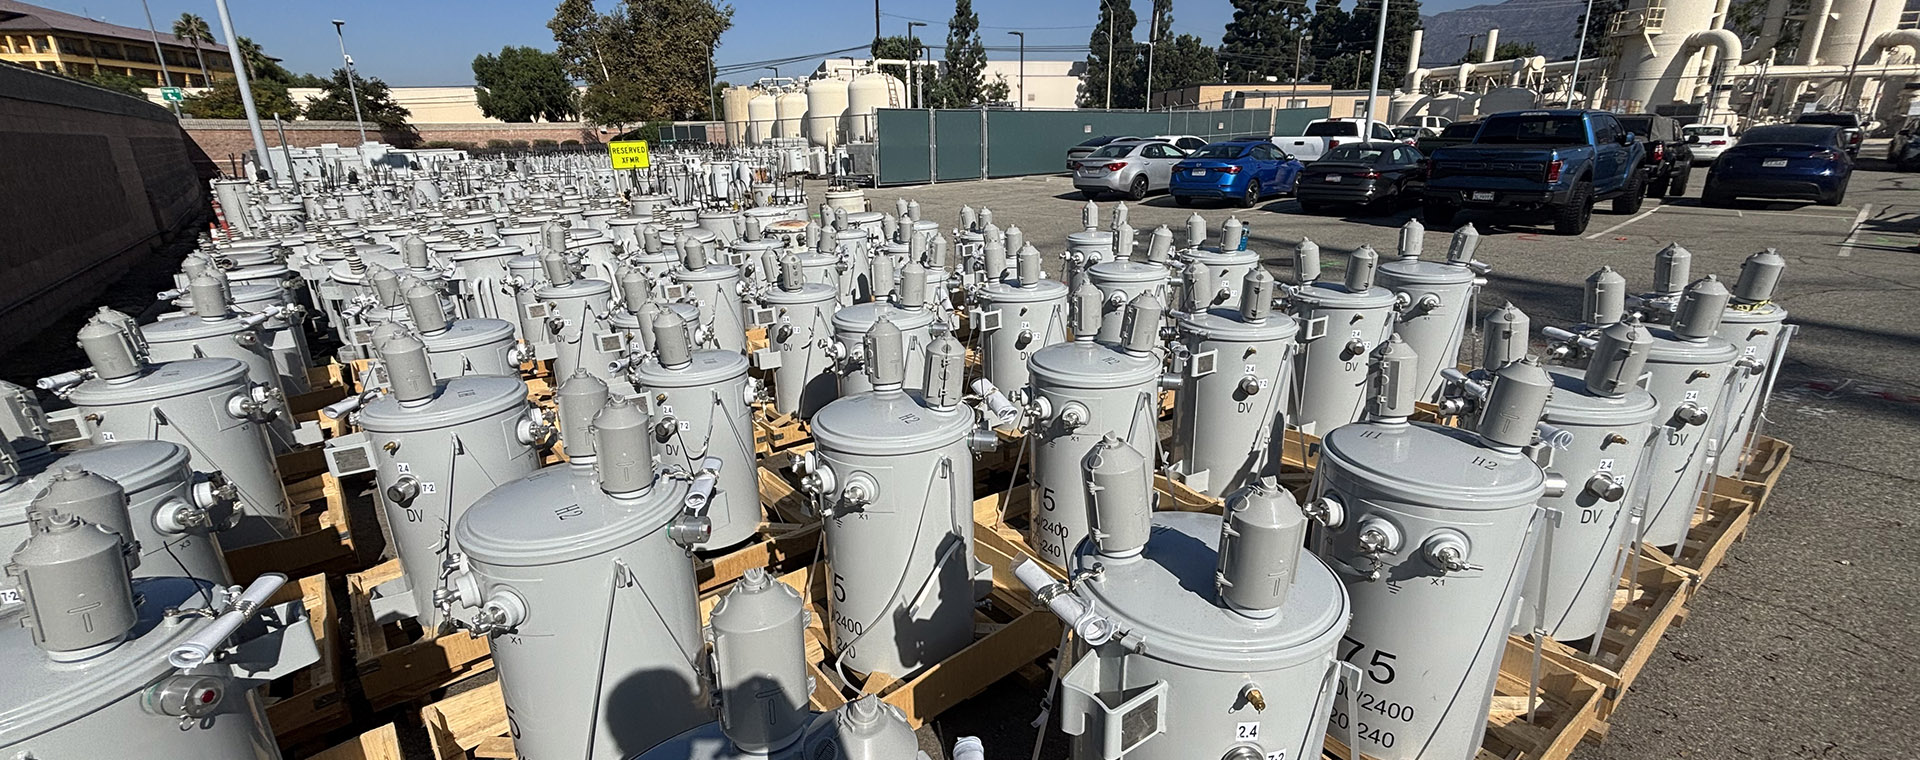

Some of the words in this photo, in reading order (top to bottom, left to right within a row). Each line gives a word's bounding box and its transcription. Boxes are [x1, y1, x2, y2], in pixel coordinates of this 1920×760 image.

[612, 146, 646, 155] RESERVED
[783, 343, 793, 351] DV
[1345, 362, 1359, 372] DV
[1238, 402, 1253, 413] DV
[898, 413, 920, 424] H2
[1360, 430, 1382, 439] H1
[1669, 433, 1689, 446] DV
[666, 444, 679, 456] DV
[1472, 456, 1498, 470] H2
[407, 509, 423, 522] DV
[555, 504, 583, 521] H2
[1580, 509, 1603, 524] DV
[1431, 578, 1445, 586] X1
[510, 636, 522, 645] X1
[1342, 635, 1397, 685] 75
[1238, 725, 1257, 738] 2.4
